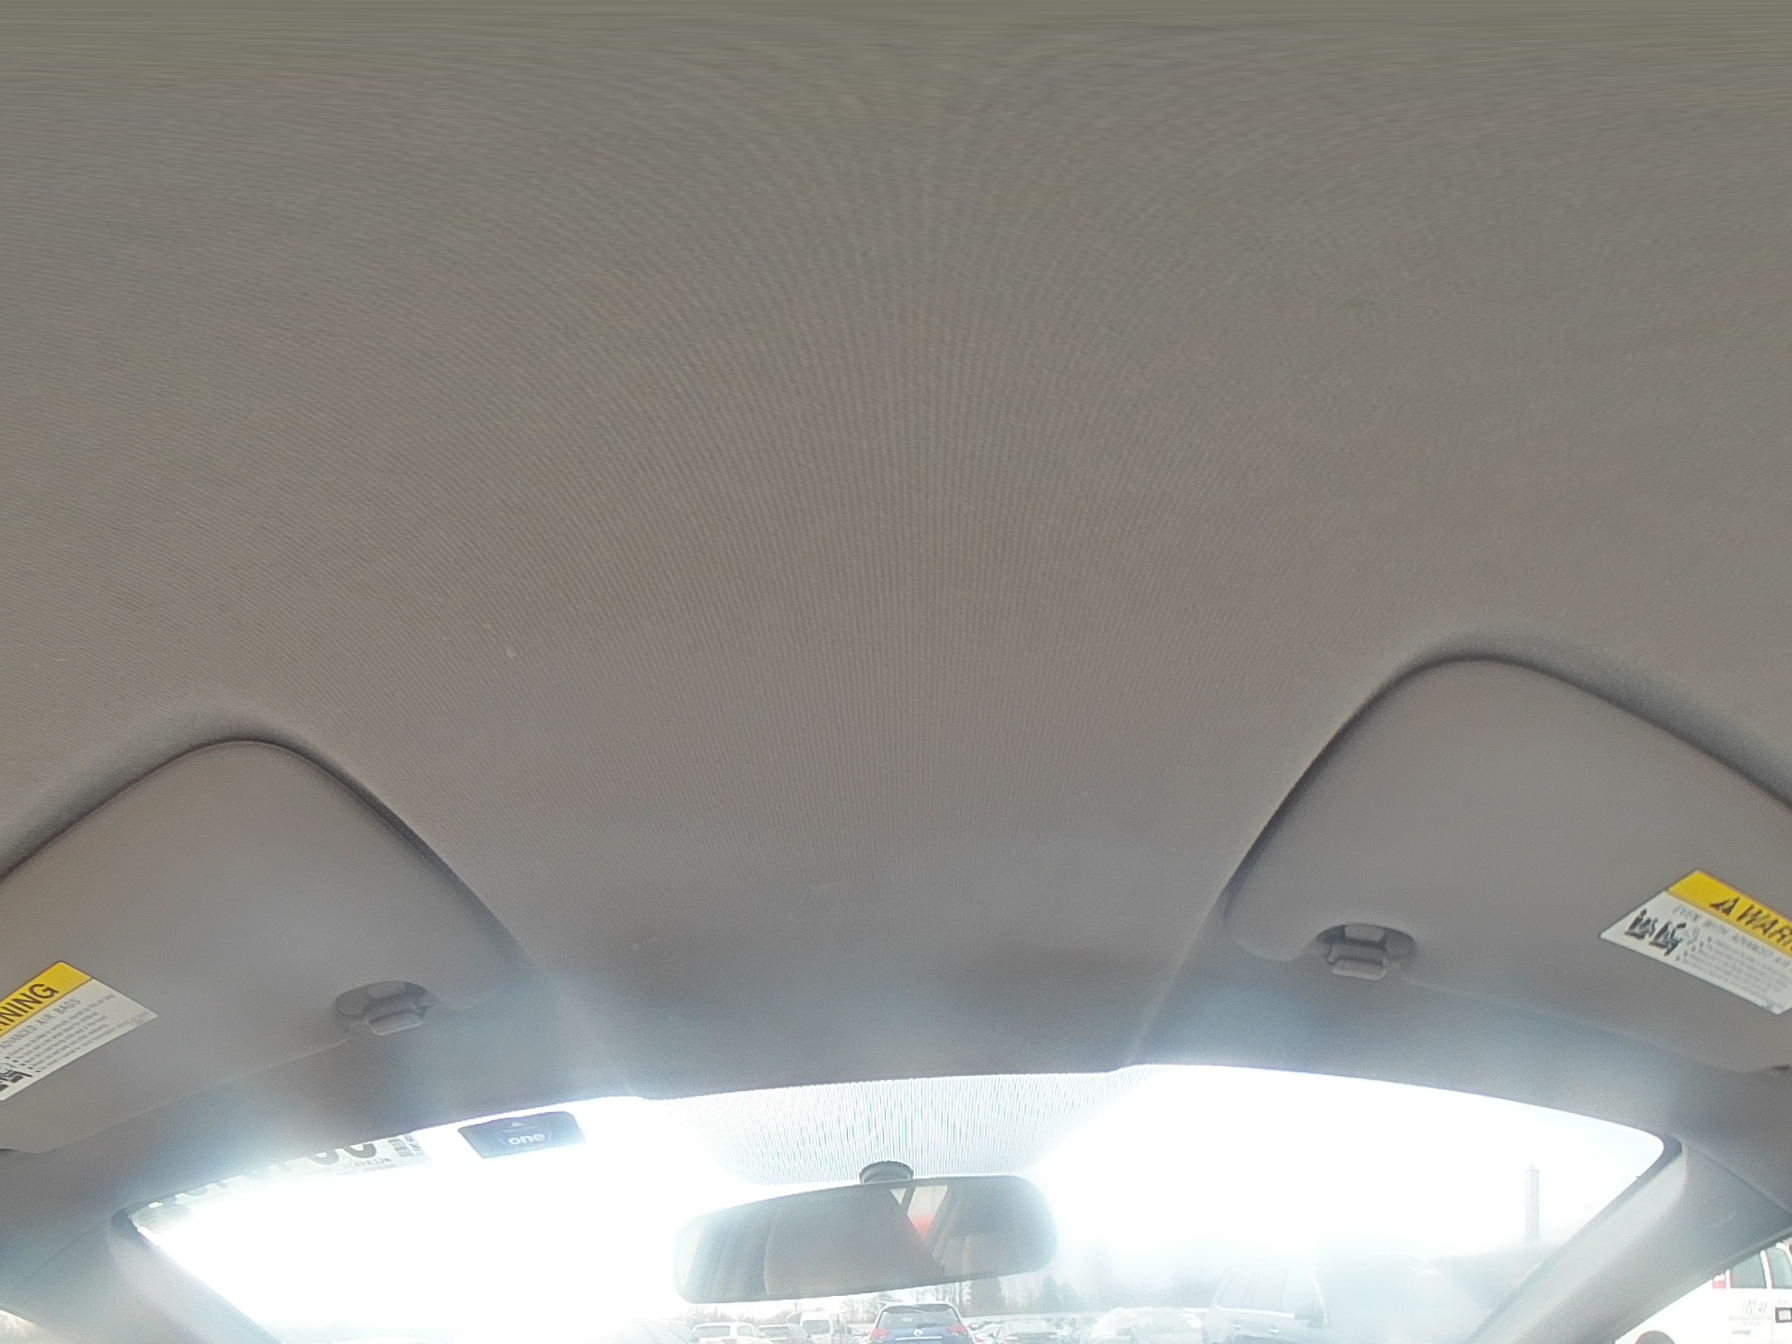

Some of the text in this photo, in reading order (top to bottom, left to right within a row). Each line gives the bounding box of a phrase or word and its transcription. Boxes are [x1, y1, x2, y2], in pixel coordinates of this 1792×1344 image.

[36, 1013, 56, 1026] AIR
[54, 997, 81, 1015] BAGS
[508, 1133, 545, 1145] one
